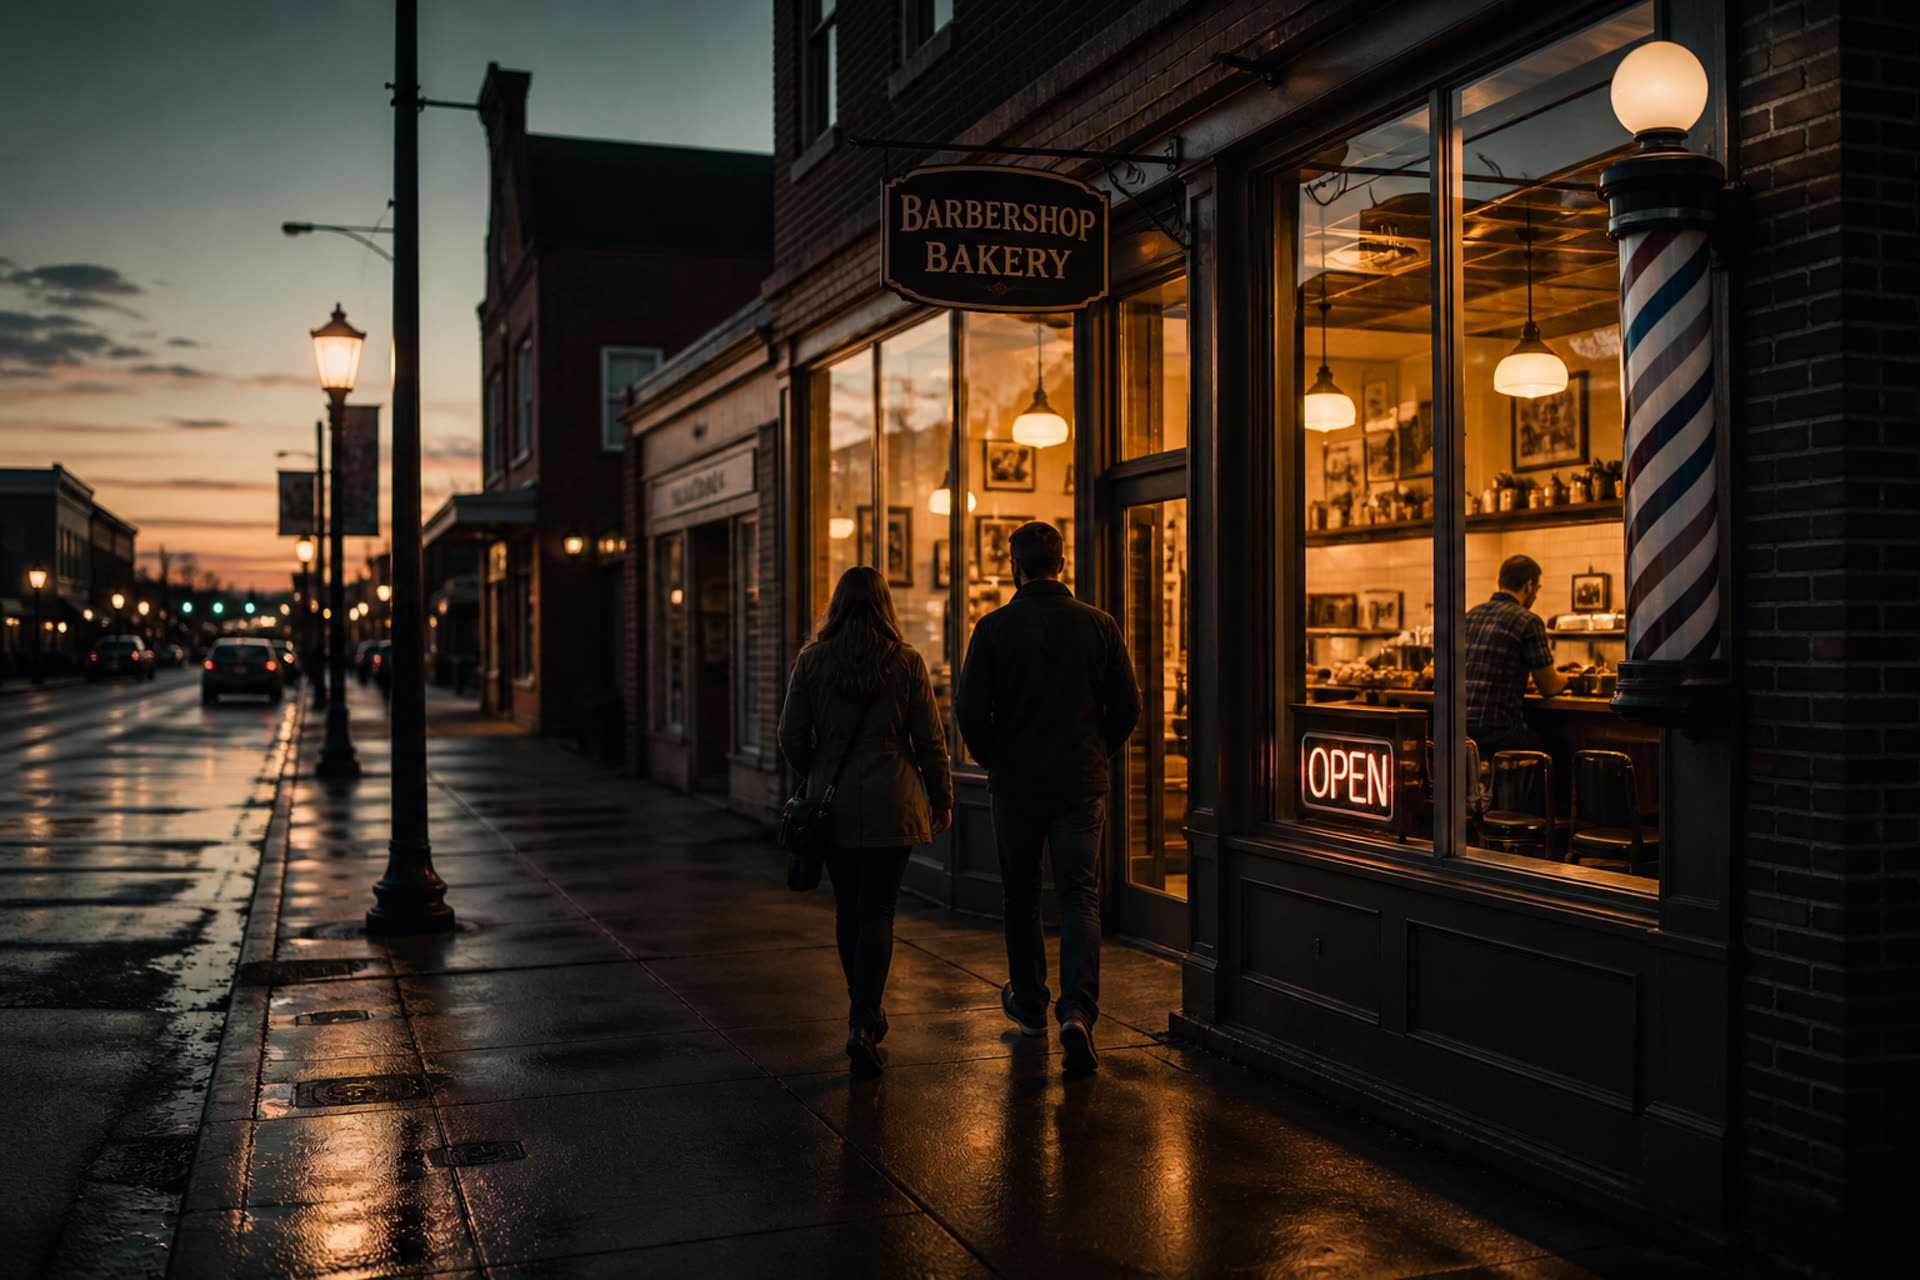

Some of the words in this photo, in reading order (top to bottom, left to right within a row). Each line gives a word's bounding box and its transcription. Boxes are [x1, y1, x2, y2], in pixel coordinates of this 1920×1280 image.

[900, 194, 1096, 242] BARBERSHOP
[924, 241, 1072, 279] BAKERY
[1308, 746, 1388, 808] OPEN
